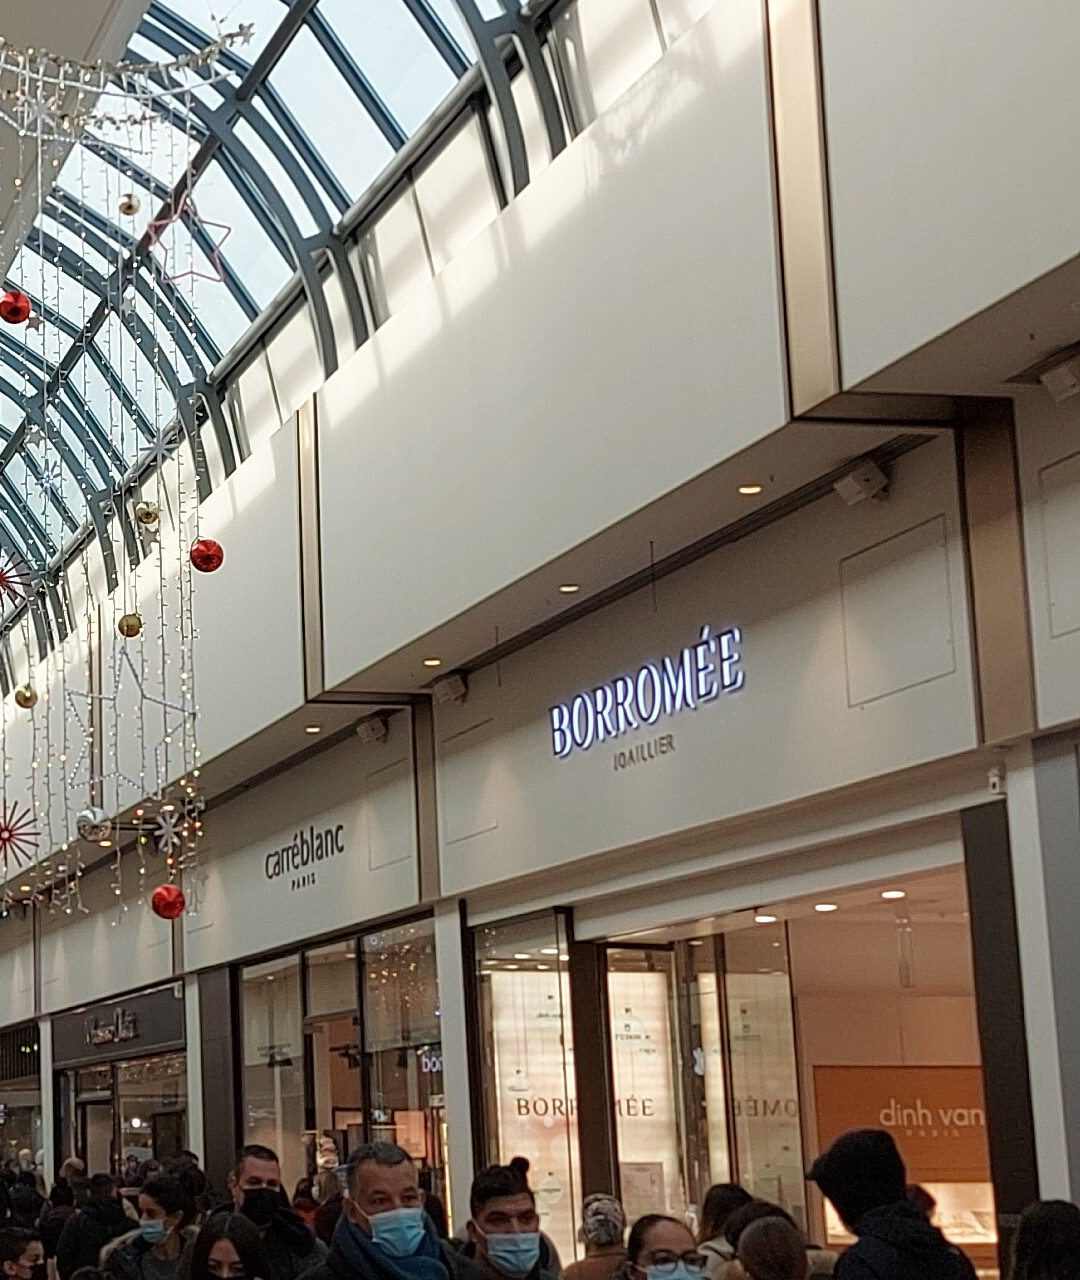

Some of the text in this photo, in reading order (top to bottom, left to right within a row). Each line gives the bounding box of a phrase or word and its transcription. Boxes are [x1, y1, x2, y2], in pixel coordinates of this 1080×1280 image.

[550, 624, 746, 758] BORROMÉE
[879, 1098, 985, 1126] dinh van
